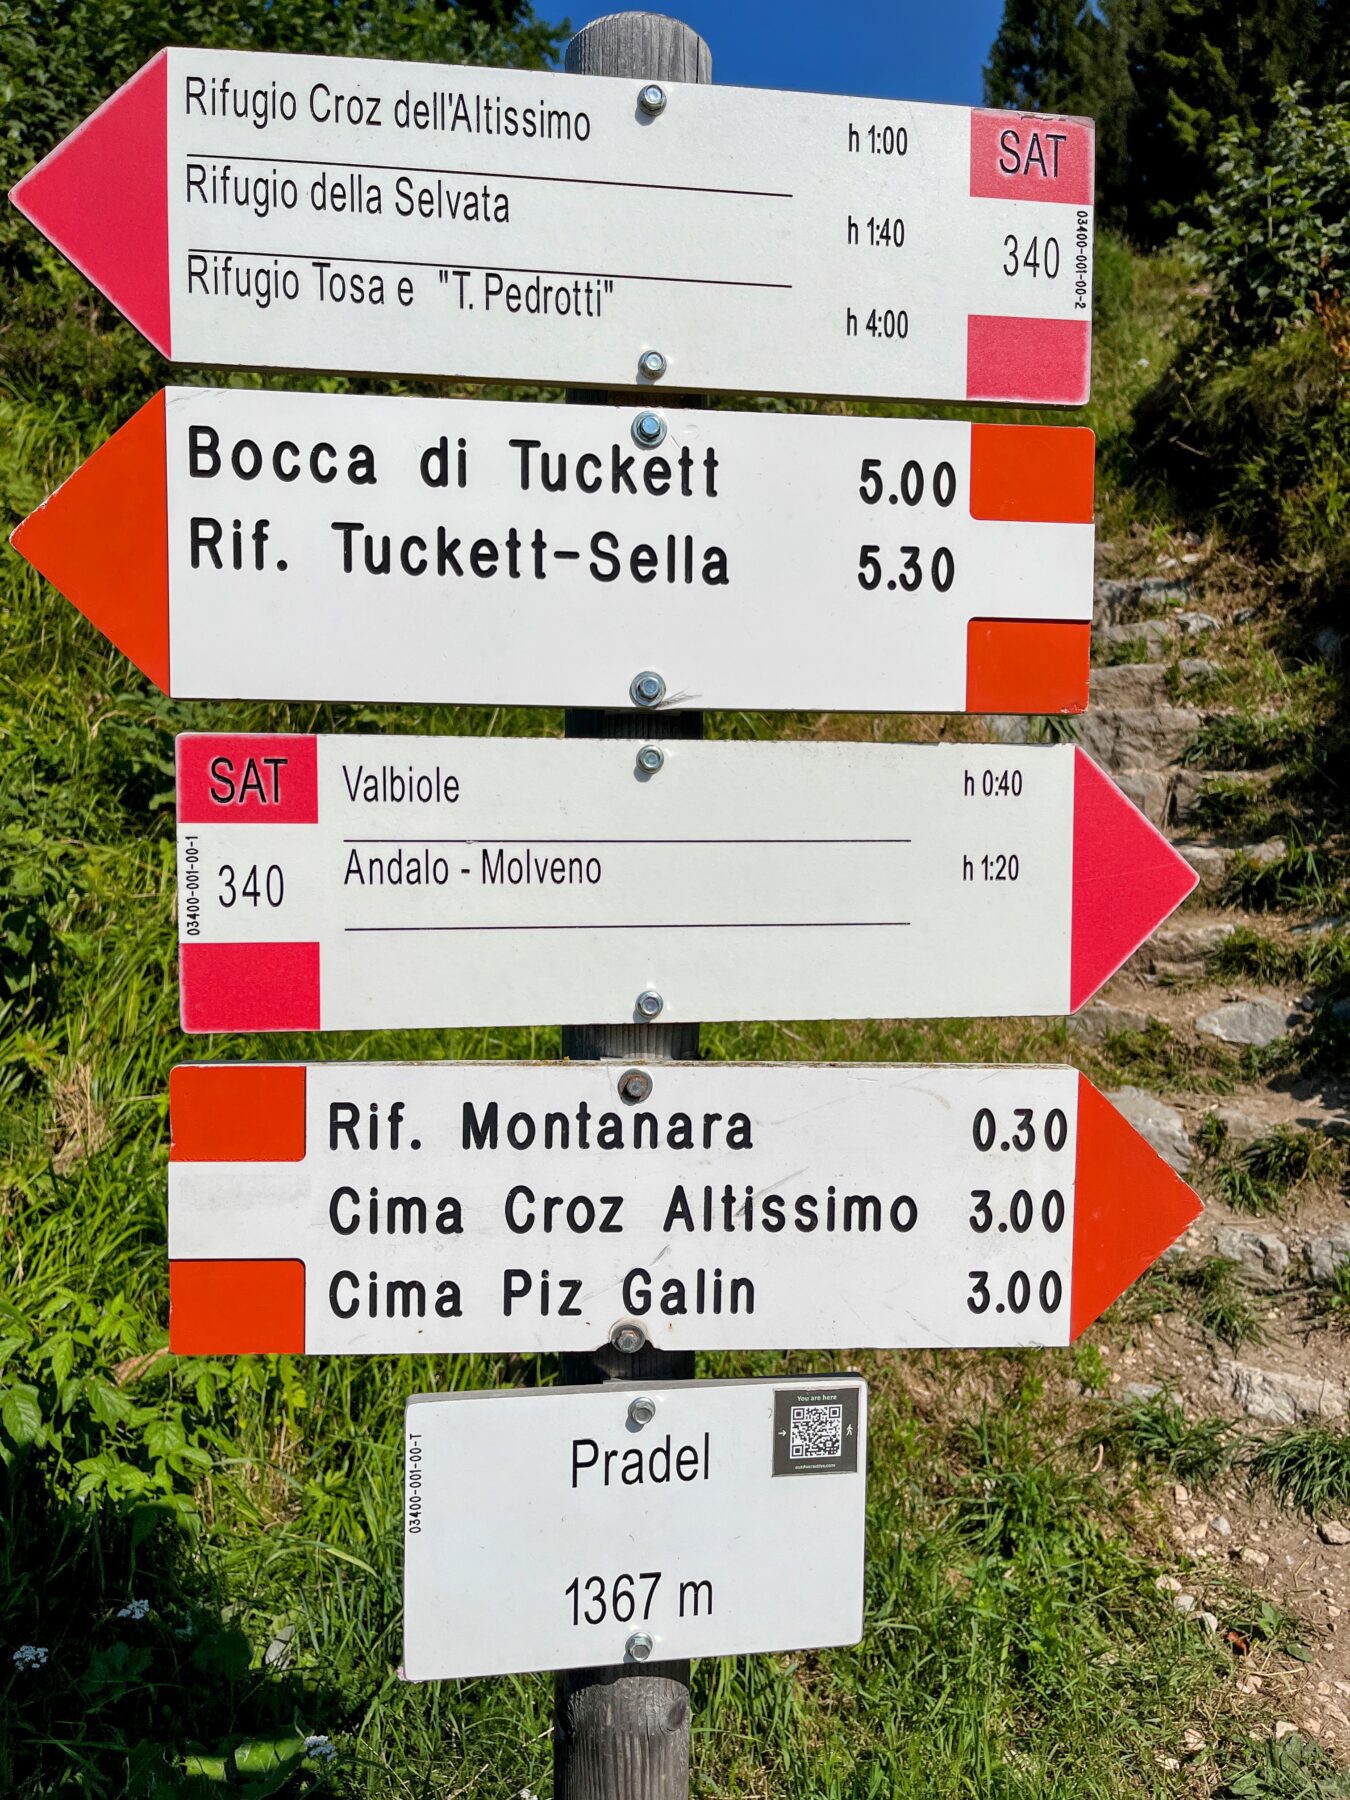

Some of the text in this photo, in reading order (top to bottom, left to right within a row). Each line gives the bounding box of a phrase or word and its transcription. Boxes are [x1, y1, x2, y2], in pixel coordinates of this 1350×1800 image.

[187, 77, 590, 141] Rifugio Croz dell'Altissimo
[848, 123, 907, 155] h 1:00
[1000, 130, 1066, 177] SAT
[187, 164, 508, 222] Rifugio della Selvata
[847, 216, 904, 247] h 1:40
[1004, 235, 1059, 278] 340
[1075, 211, 1088, 308] 03400-001-00-2
[188, 255, 613, 316] Rifugio Tosa e "T. Pedrotti"
[846, 308, 908, 338] h 4:00
[189, 425, 718, 497] Bocca di Tuckett
[860, 459, 956, 507] 5.00
[191, 517, 729, 585] Rif. Tuckett-Sella
[858, 545, 954, 592] 5.30
[211, 757, 288, 803] SAT
[343, 766, 459, 802] Valbiole
[964, 770, 1022, 796] h 0:40
[186, 837, 200, 935] 03400-001-00-1
[219, 865, 283, 907] 340
[344, 849, 448, 884] Andalo
[483, 849, 601, 884] Molveno
[963, 855, 1018, 880] h 1:20
[330, 1100, 753, 1150] Rif. Montanara
[973, 1108, 1067, 1151] 0.30
[330, 1185, 917, 1235] Cima Croz Altissimo
[970, 1190, 1064, 1233] 3.00
[329, 1268, 754, 1318] Cima Piz Galin
[967, 1270, 1062, 1314] 3.00
[409, 1434, 421, 1533] 03400-001-00-T
[573, 1432, 709, 1488] Pradel
[566, 1572, 712, 1625] 1367 m
